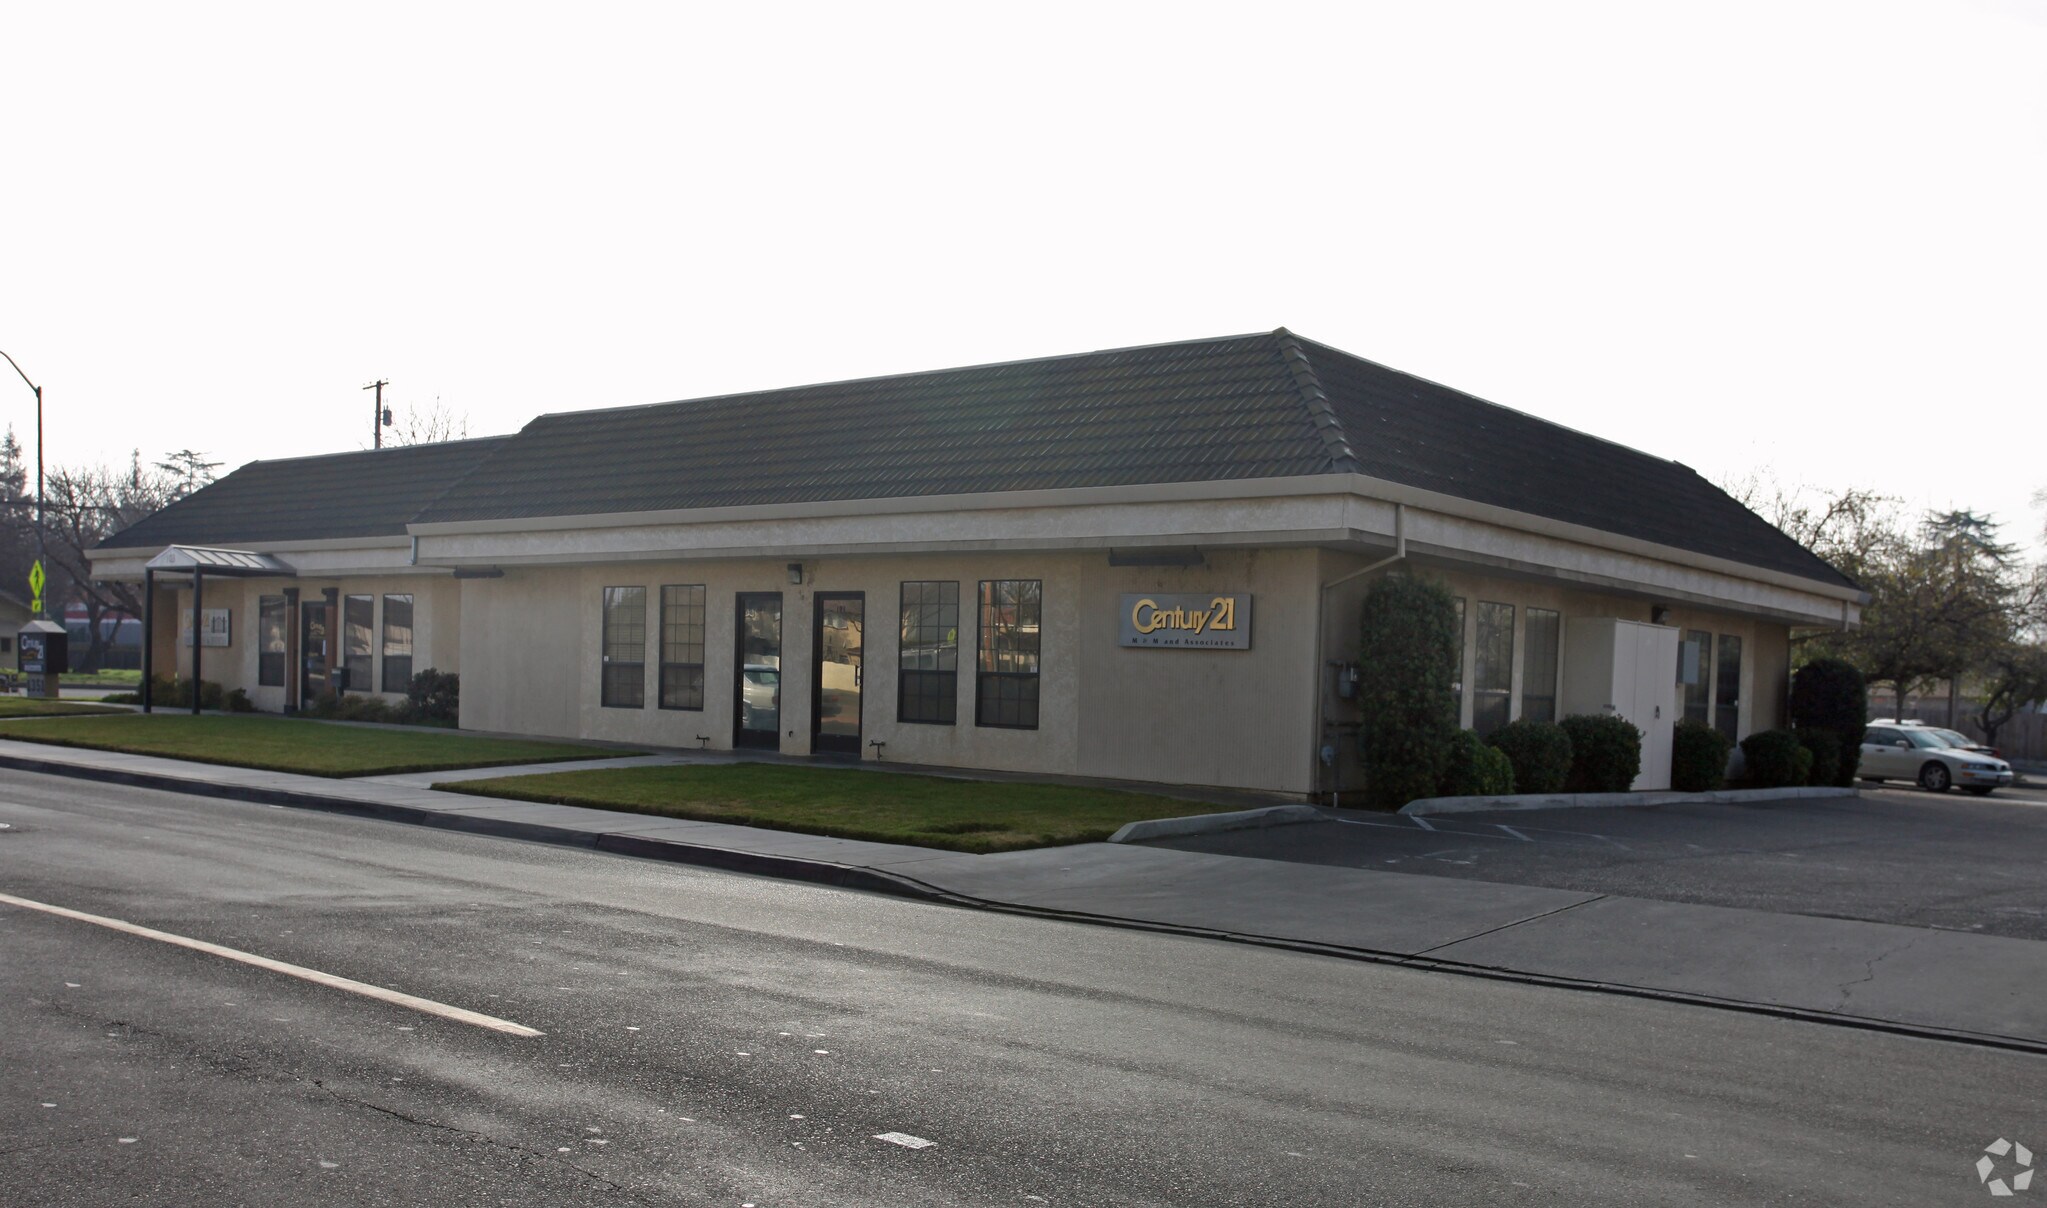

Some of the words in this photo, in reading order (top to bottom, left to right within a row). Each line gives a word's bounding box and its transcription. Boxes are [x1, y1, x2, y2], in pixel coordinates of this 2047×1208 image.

[1132, 598, 1211, 634] Century
[1210, 597, 1235, 630] 21
[1184, 638, 1235, 647] Associates
